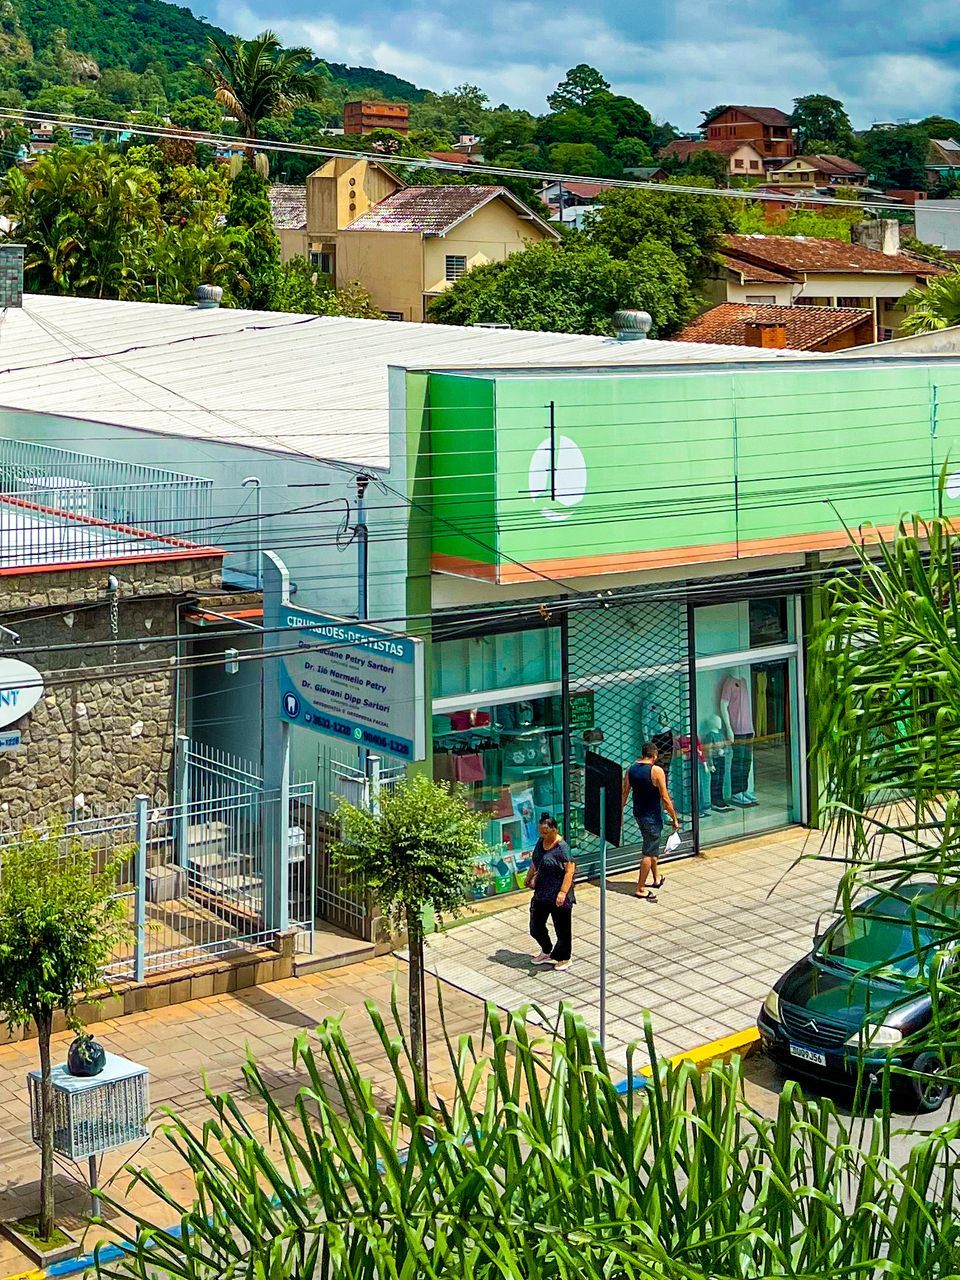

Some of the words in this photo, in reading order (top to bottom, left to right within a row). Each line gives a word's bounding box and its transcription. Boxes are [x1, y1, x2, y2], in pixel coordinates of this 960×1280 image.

[316, 645, 343, 659] uciane
[345, 651, 366, 667] Petry
[367, 660, 394, 674] Sartori
[304, 662, 315, 672] Dr.
[366, 680, 387, 694] Petry
[301, 680, 312, 690] Dr.
[314, 683, 343, 698] Giovani
[344, 693, 362, 705] Dipp
[363, 698, 390, 713] Sartori
